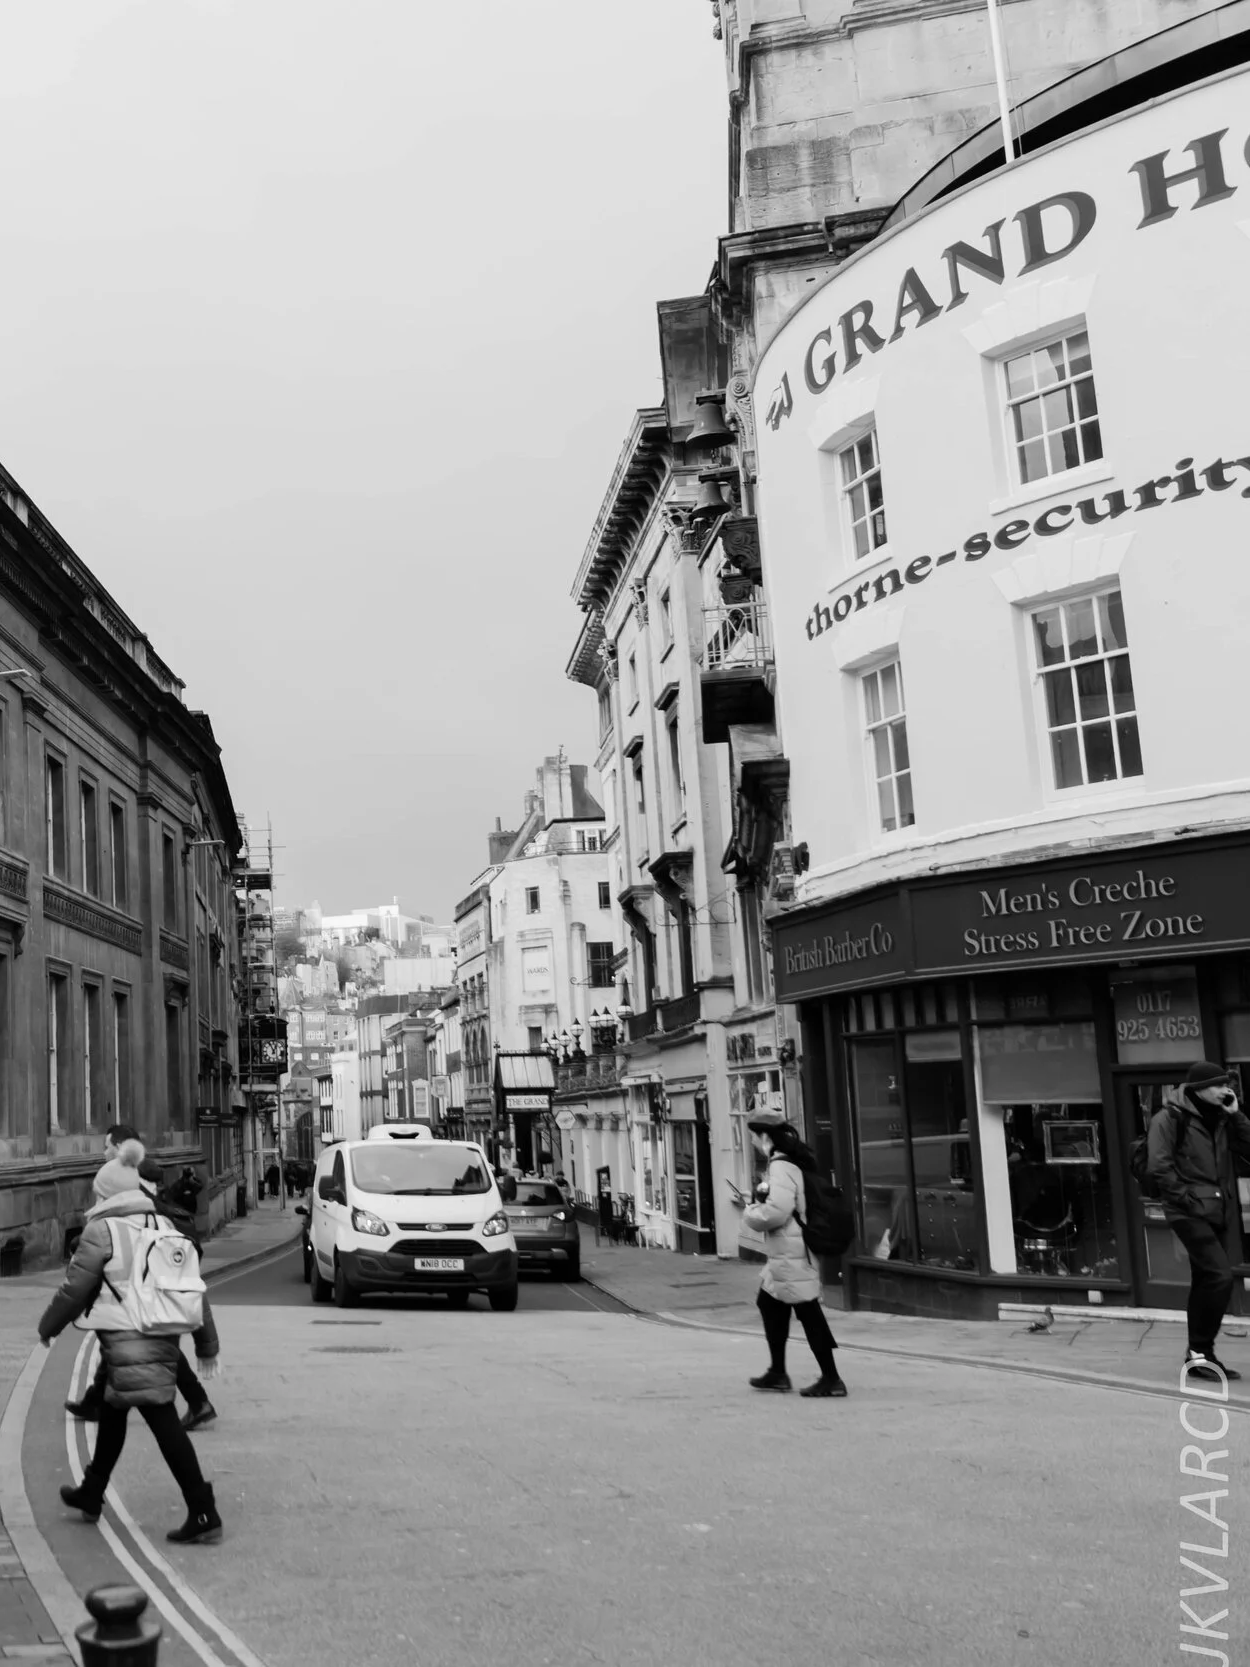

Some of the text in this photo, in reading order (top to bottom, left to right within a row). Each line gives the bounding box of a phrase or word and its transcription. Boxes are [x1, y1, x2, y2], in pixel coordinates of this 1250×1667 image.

[804, 127, 1250, 396] GRAND H
[979, 870, 1176, 917] Men's Creche
[785, 923, 892, 975] British Barber Co
[964, 911, 1203, 956] Stress Free Zone
[1137, 990, 1171, 1013] 0117
[1117, 1016, 1199, 1041] 925 4653
